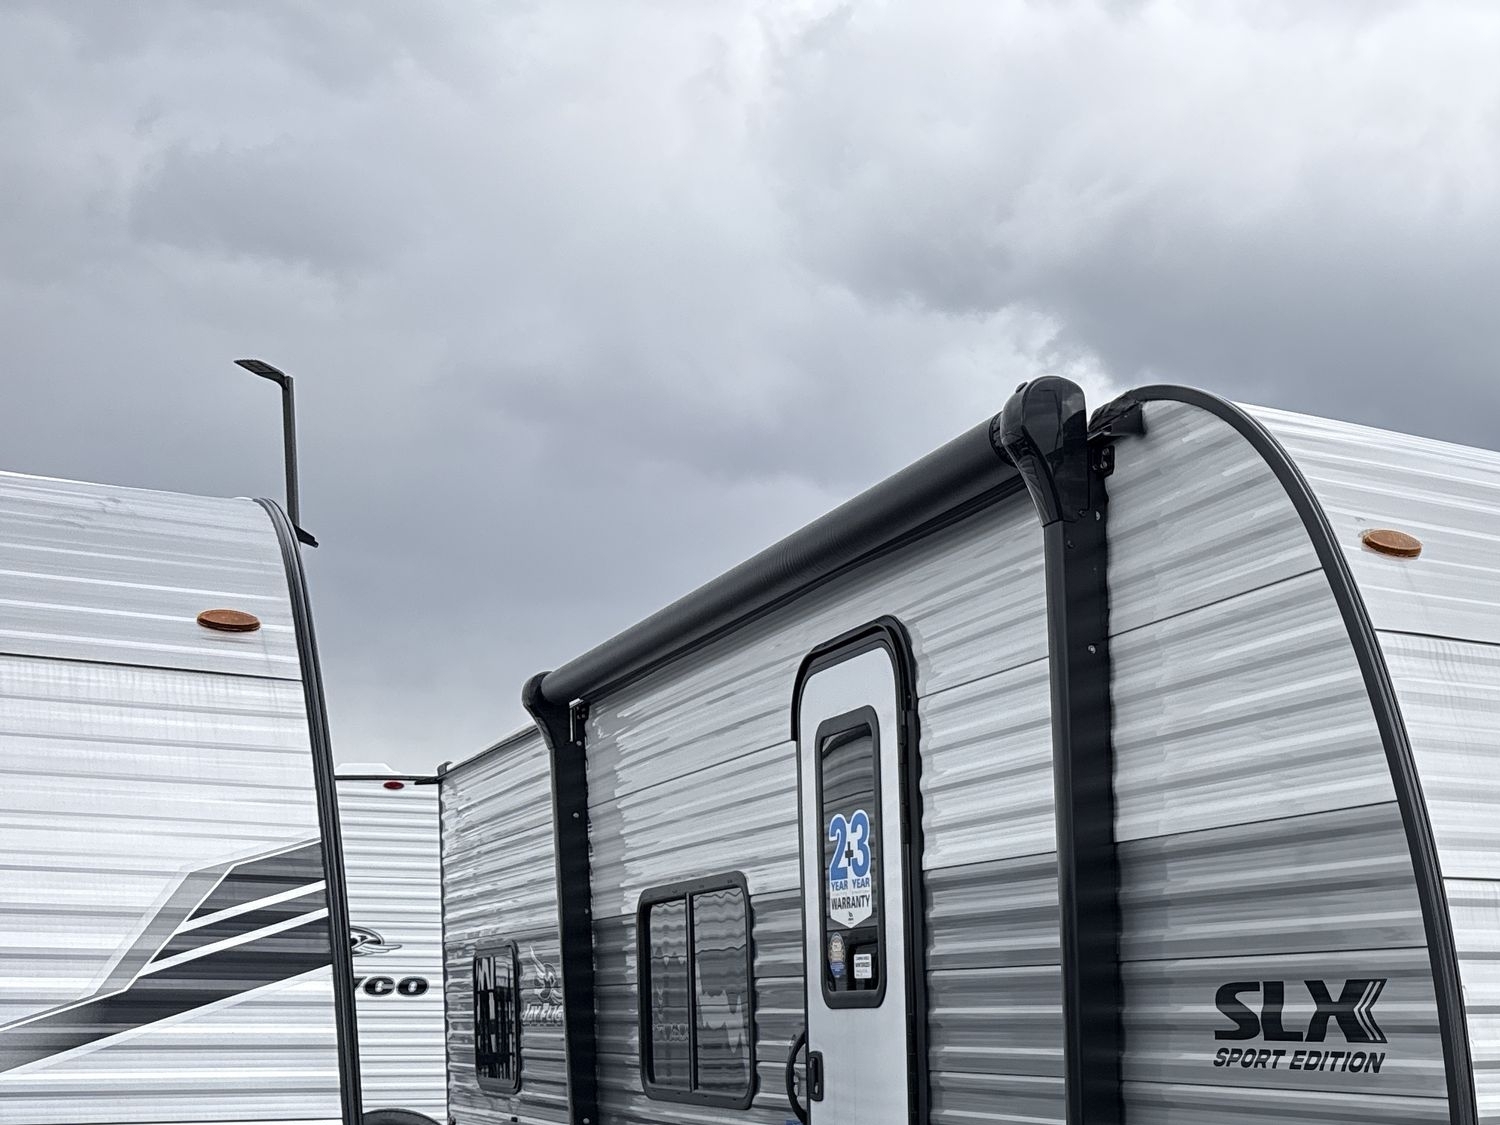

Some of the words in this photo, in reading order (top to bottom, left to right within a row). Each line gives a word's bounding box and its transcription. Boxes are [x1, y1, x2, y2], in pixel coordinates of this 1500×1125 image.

[831, 880, 848, 891] YEAR
[852, 878, 870, 889] YEAR
[831, 894, 870, 910] WARRANTY
[1215, 979, 1388, 1043] SLX
[1213, 1047, 1286, 1069] SPORT
[1289, 1050, 1386, 1074] EDITION
